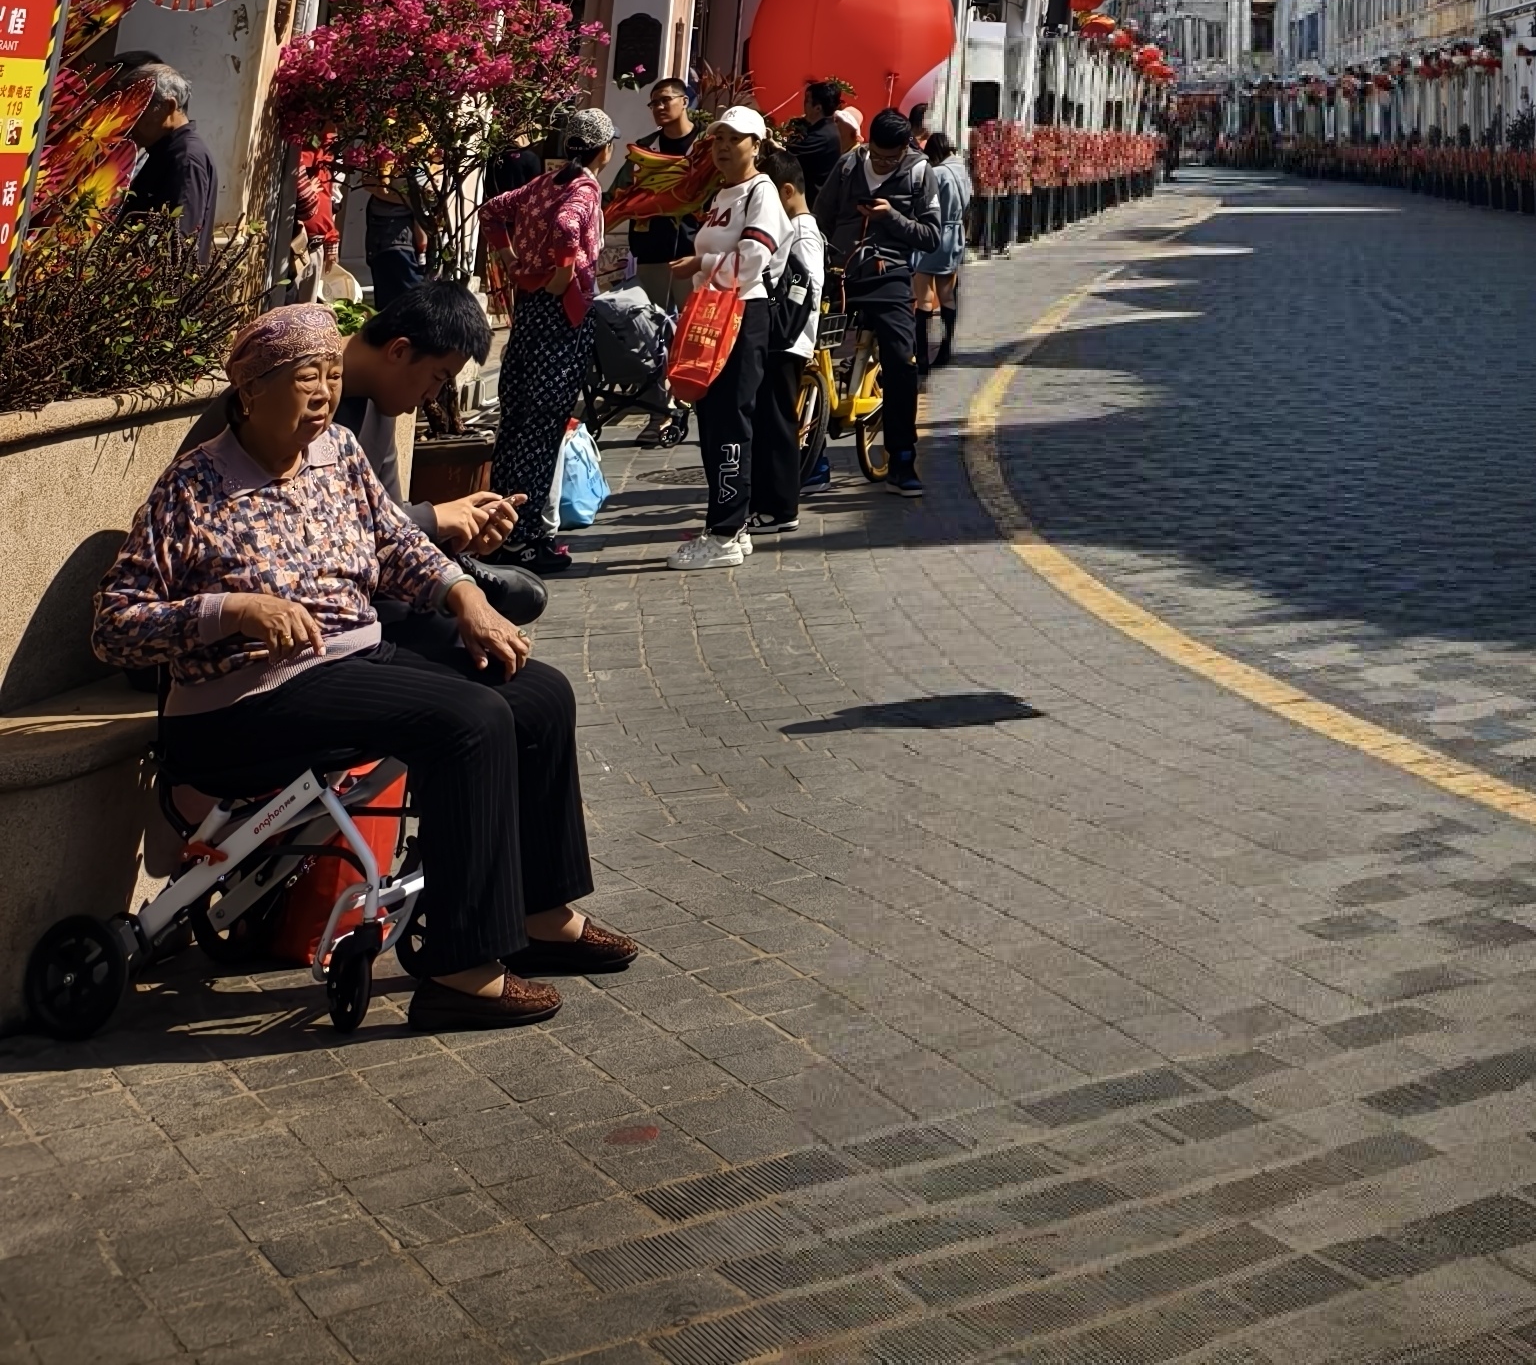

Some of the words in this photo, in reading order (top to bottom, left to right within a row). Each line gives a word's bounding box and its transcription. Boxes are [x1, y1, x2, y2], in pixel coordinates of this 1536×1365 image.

[7, 101, 23, 116] 119
[2, 181, 17, 206] 话
[718, 443, 741, 504] FILA
